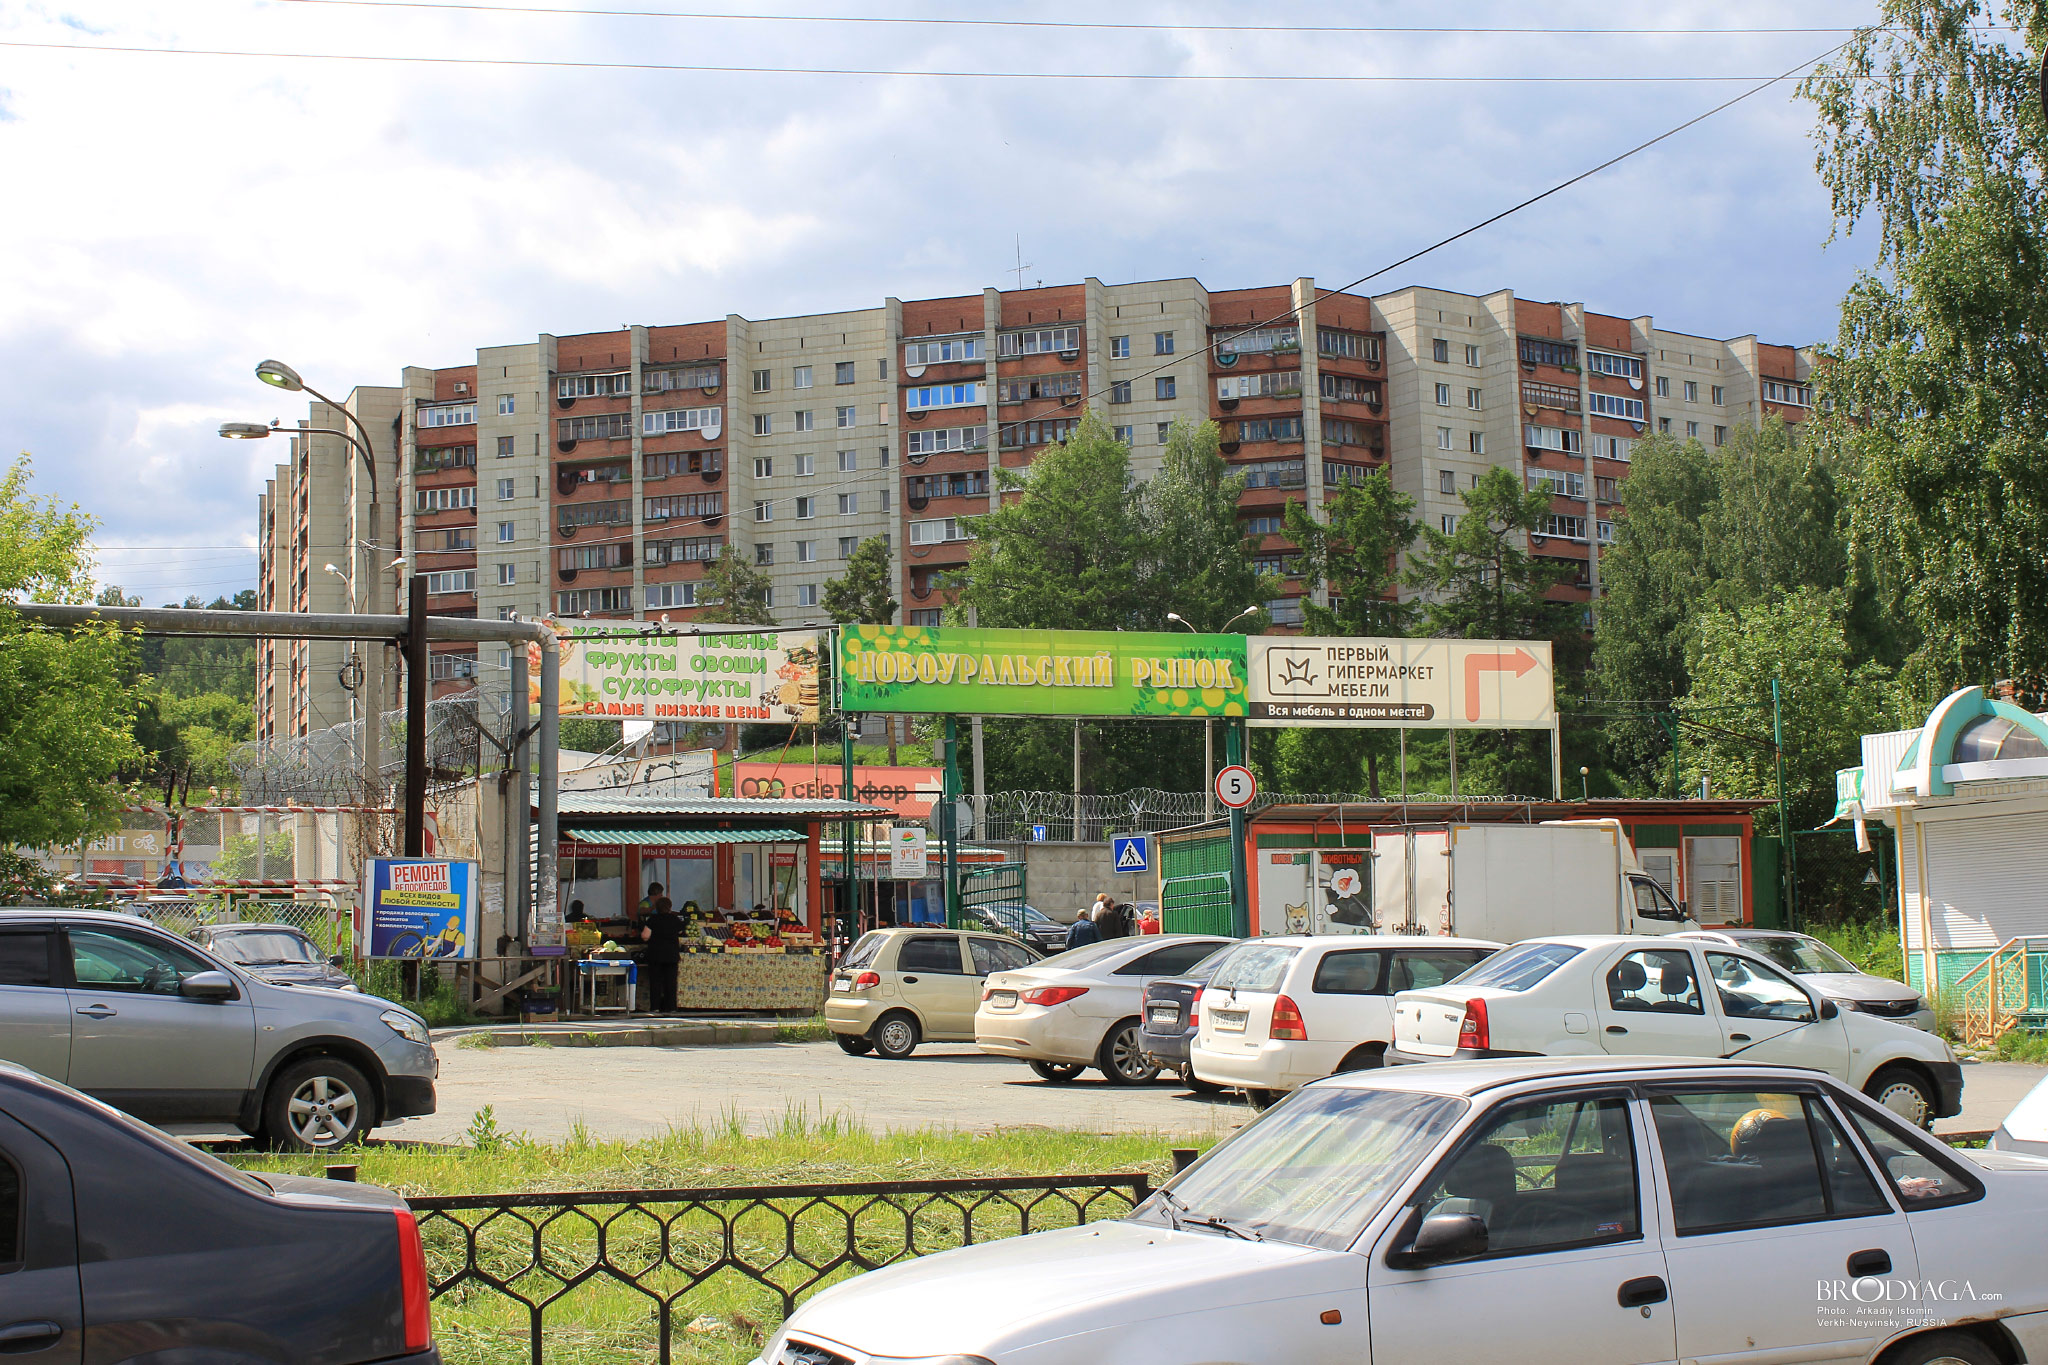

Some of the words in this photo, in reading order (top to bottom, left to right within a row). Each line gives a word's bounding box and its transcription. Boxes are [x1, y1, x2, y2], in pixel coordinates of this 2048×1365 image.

[572, 625, 678, 648] КОНФЕТЫ
[699, 632, 778, 651] ПЕЧЕНЬЕ
[1327, 645, 1389, 661] ПЕРВЫЙ
[585, 651, 677, 675] ФРУКТЫ
[690, 655, 767, 674] ОВОЩИ
[854, 650, 1113, 688] НОВОУРАЛЬСКИЙ
[1131, 656, 1234, 689] РЫНОК
[1327, 665, 1434, 680] ГИПЕРМАРКЕТ
[603, 676, 751, 702] СУХОФРУКТЫ
[1328, 683, 1389, 697] МЕБЕЛИ
[583, 701, 644, 716] САМЫЕ
[655, 704, 720, 718] НИЗКИЕ
[725, 705, 771, 720] ЦЕНЫ
[1268, 705, 1288, 717] Вся
[1292, 705, 1335, 718] мебель
[1338, 708, 1346, 717] в
[1349, 708, 1386, 720] одном
[1389, 705, 1426, 718] месте!
[1230, 778, 1241, 795] 5
[643, 848, 657, 856] МЫ
[1321, 854, 1363, 865] ЖИВОТНЫХ
[394, 865, 447, 883] РЕМОНТ
[395, 882, 448, 892] ВЕЛОСИПЕДОВ
[384, 897, 410, 905] ЛЮБОЙ
